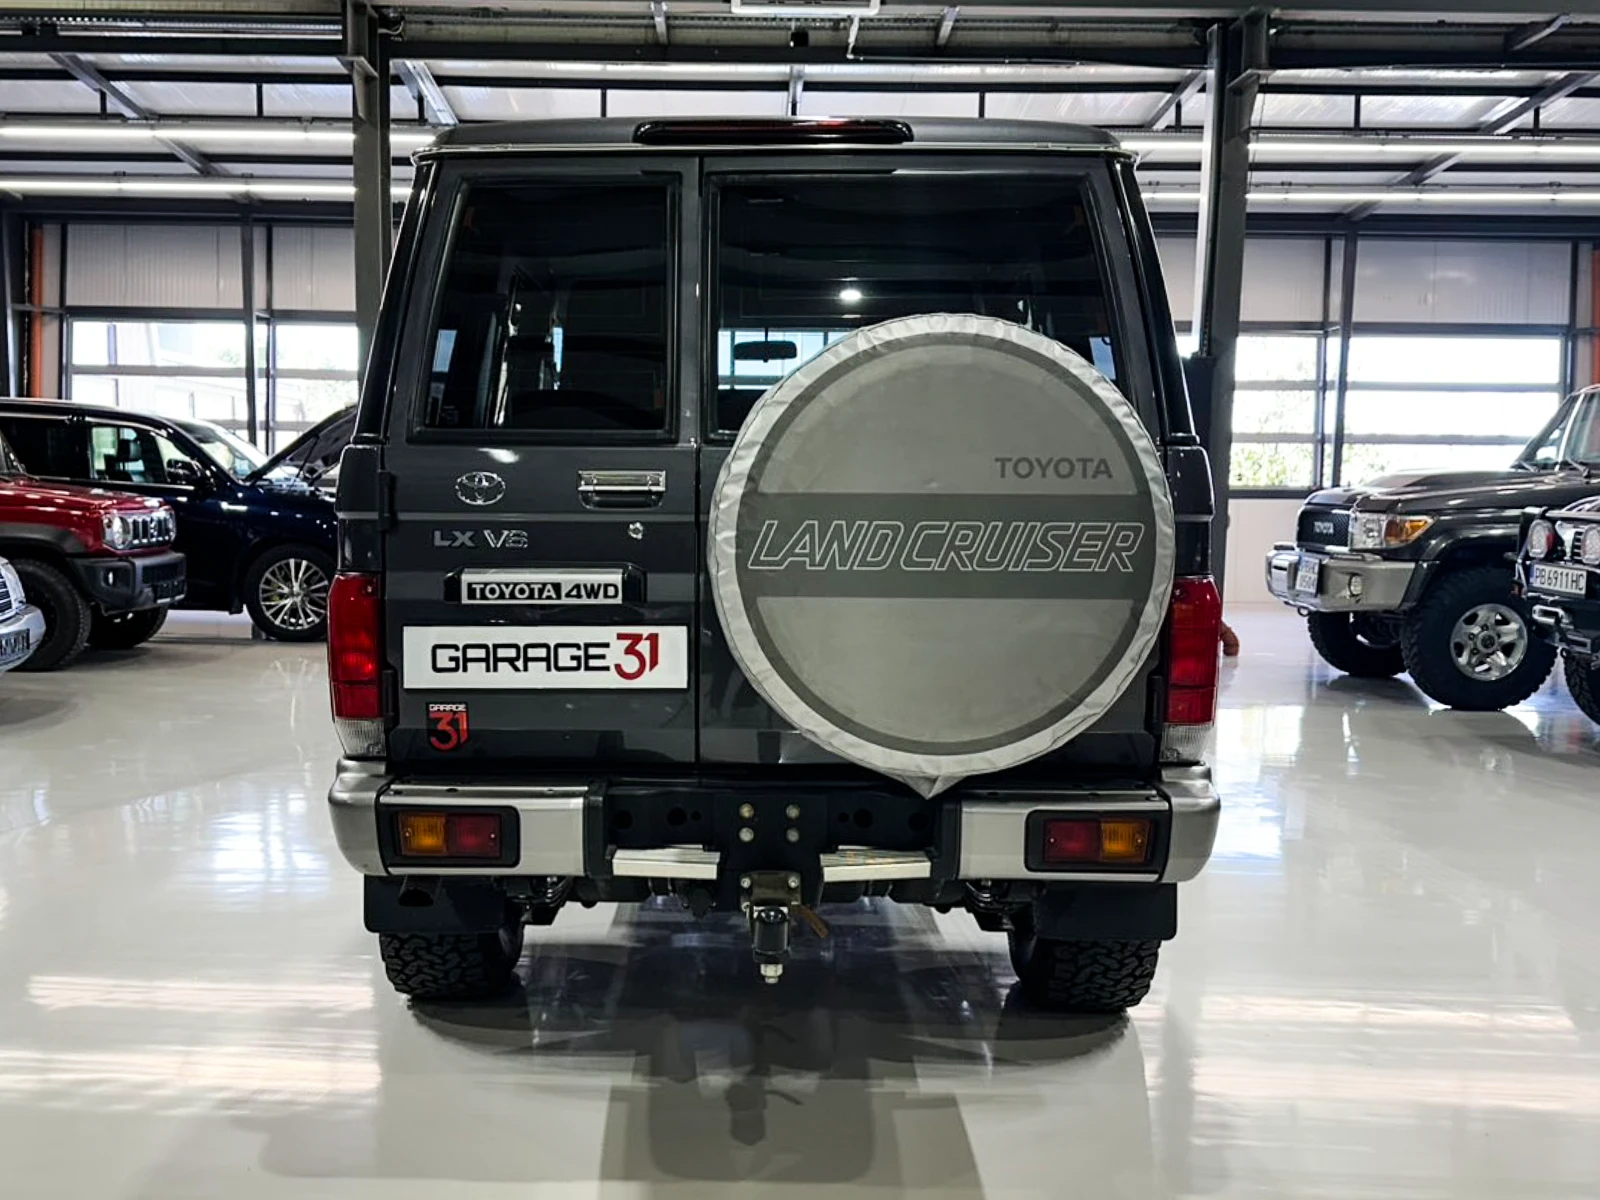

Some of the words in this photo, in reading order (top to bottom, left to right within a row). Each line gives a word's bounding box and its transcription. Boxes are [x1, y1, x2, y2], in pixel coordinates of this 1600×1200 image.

[995, 457, 1113, 479] TOYOTA
[433, 530, 476, 547] LX
[748, 519, 904, 570] LAND
[900, 521, 1145, 572] CRUISER
[471, 583, 557, 599] TOYOTA
[564, 583, 619, 599] 4WD
[429, 703, 467, 712] GARAGE
[429, 711, 468, 750] 31
